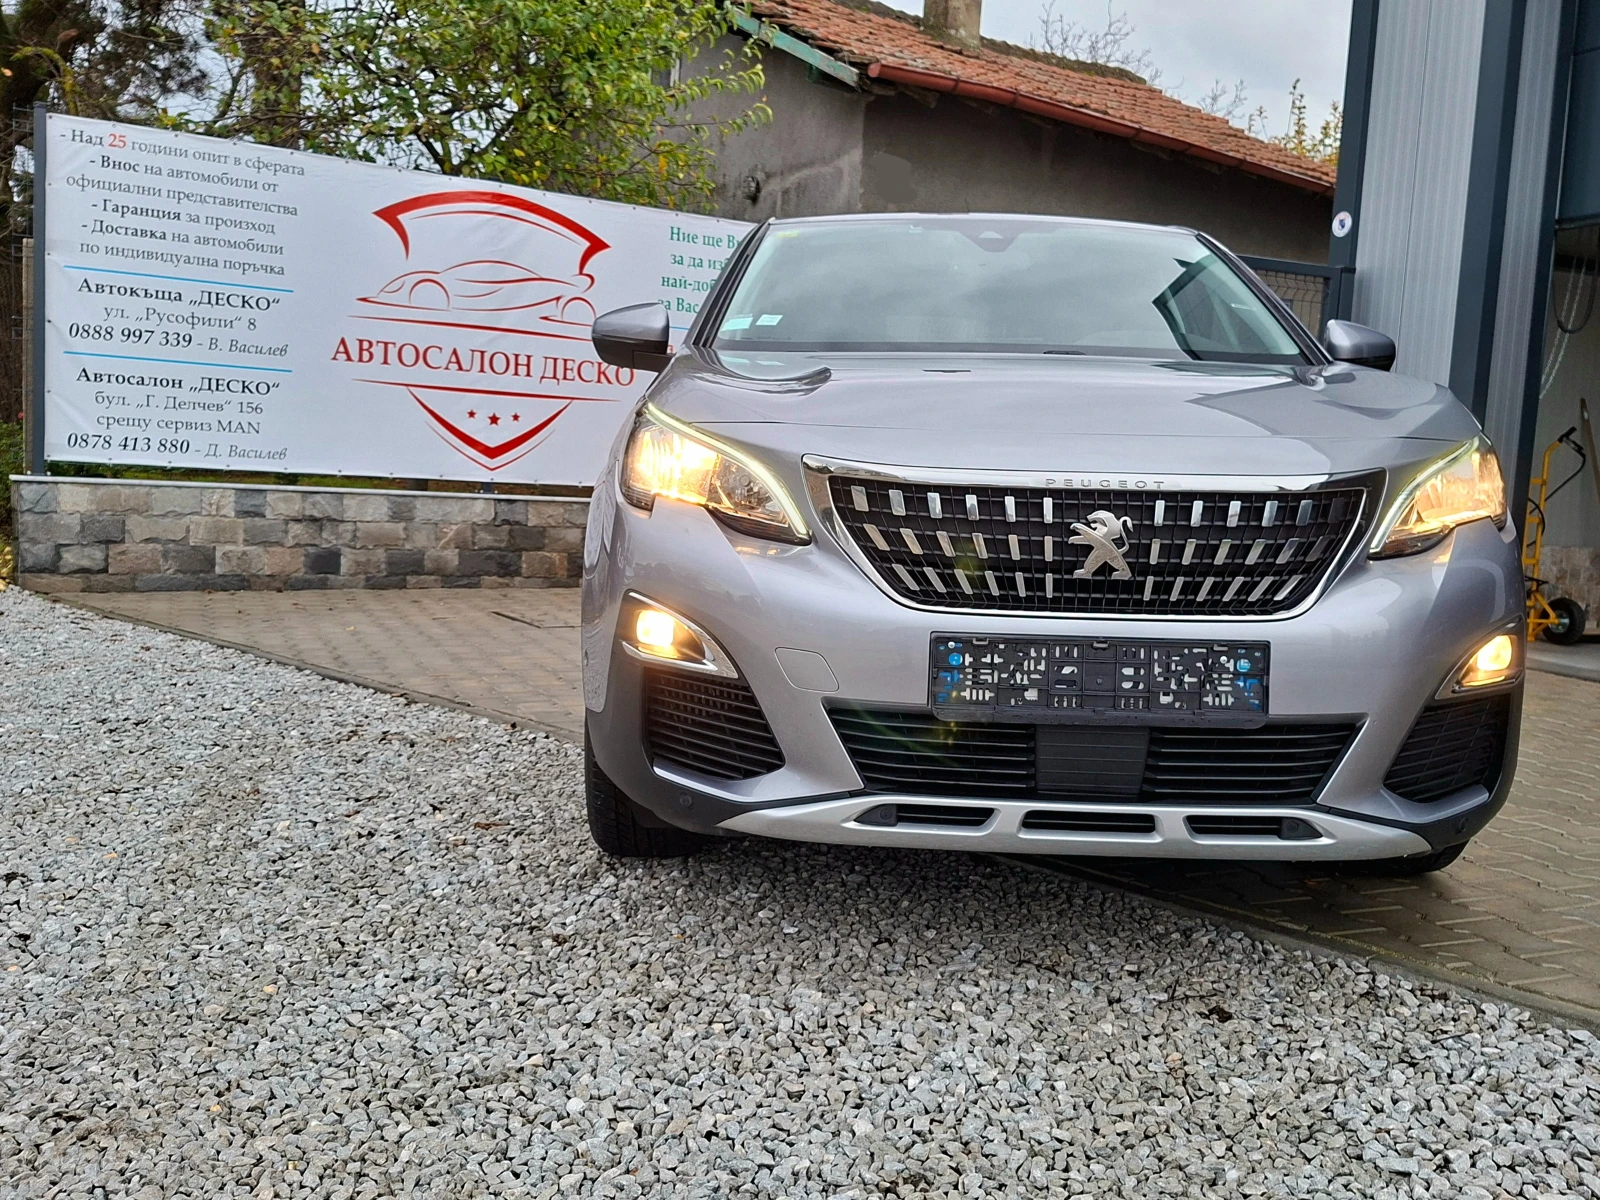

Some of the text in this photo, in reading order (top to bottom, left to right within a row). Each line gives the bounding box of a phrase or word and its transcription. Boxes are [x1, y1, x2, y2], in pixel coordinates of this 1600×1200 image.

[71, 130, 104, 147] Над
[107, 133, 127, 148] 25
[131, 140, 188, 159] години
[192, 150, 230, 166] опит
[233, 154, 241, 166] в
[245, 156, 305, 176] сферата
[100, 155, 140, 173] Внос
[144, 164, 163, 176] на
[166, 167, 258, 191] автомобили
[262, 181, 279, 192] от
[66, 173, 298, 216] официални представителства
[101, 199, 181, 222] Гаранция
[185, 212, 200, 223] за
[205, 215, 275, 235] произход
[91, 220, 167, 241] Доставка
[171, 231, 190, 243] на
[193, 235, 284, 255] автомобили
[670, 226, 698, 244] Ние
[703, 235, 722, 248] ще
[80, 242, 285, 277] по индивидуална поръчка
[670, 254, 684, 265] за
[687, 257, 703, 270] да
[77, 277, 183, 303] Автокъща
[103, 306, 129, 322] ул.
[247, 318, 257, 330] 8
[68, 322, 114, 341] 0888
[120, 327, 154, 345] 997
[158, 330, 193, 348] 339
[208, 337, 223, 352] В.
[228, 339, 289, 357] Василев
[331, 336, 534, 378] АВТОСАЛОН
[75, 367, 184, 389] Автосалон
[94, 390, 130, 408] бул.
[237, 402, 263, 414] 156
[96, 415, 261, 434] срещу сервиз MAN
[67, 432, 112, 450] 0878
[118, 436, 151, 452] 413
[157, 438, 190, 454] 880
[204, 443, 222, 458] Д.
[228, 445, 288, 460] Василев
[1046, 479, 1164, 489] PEUGEOT
